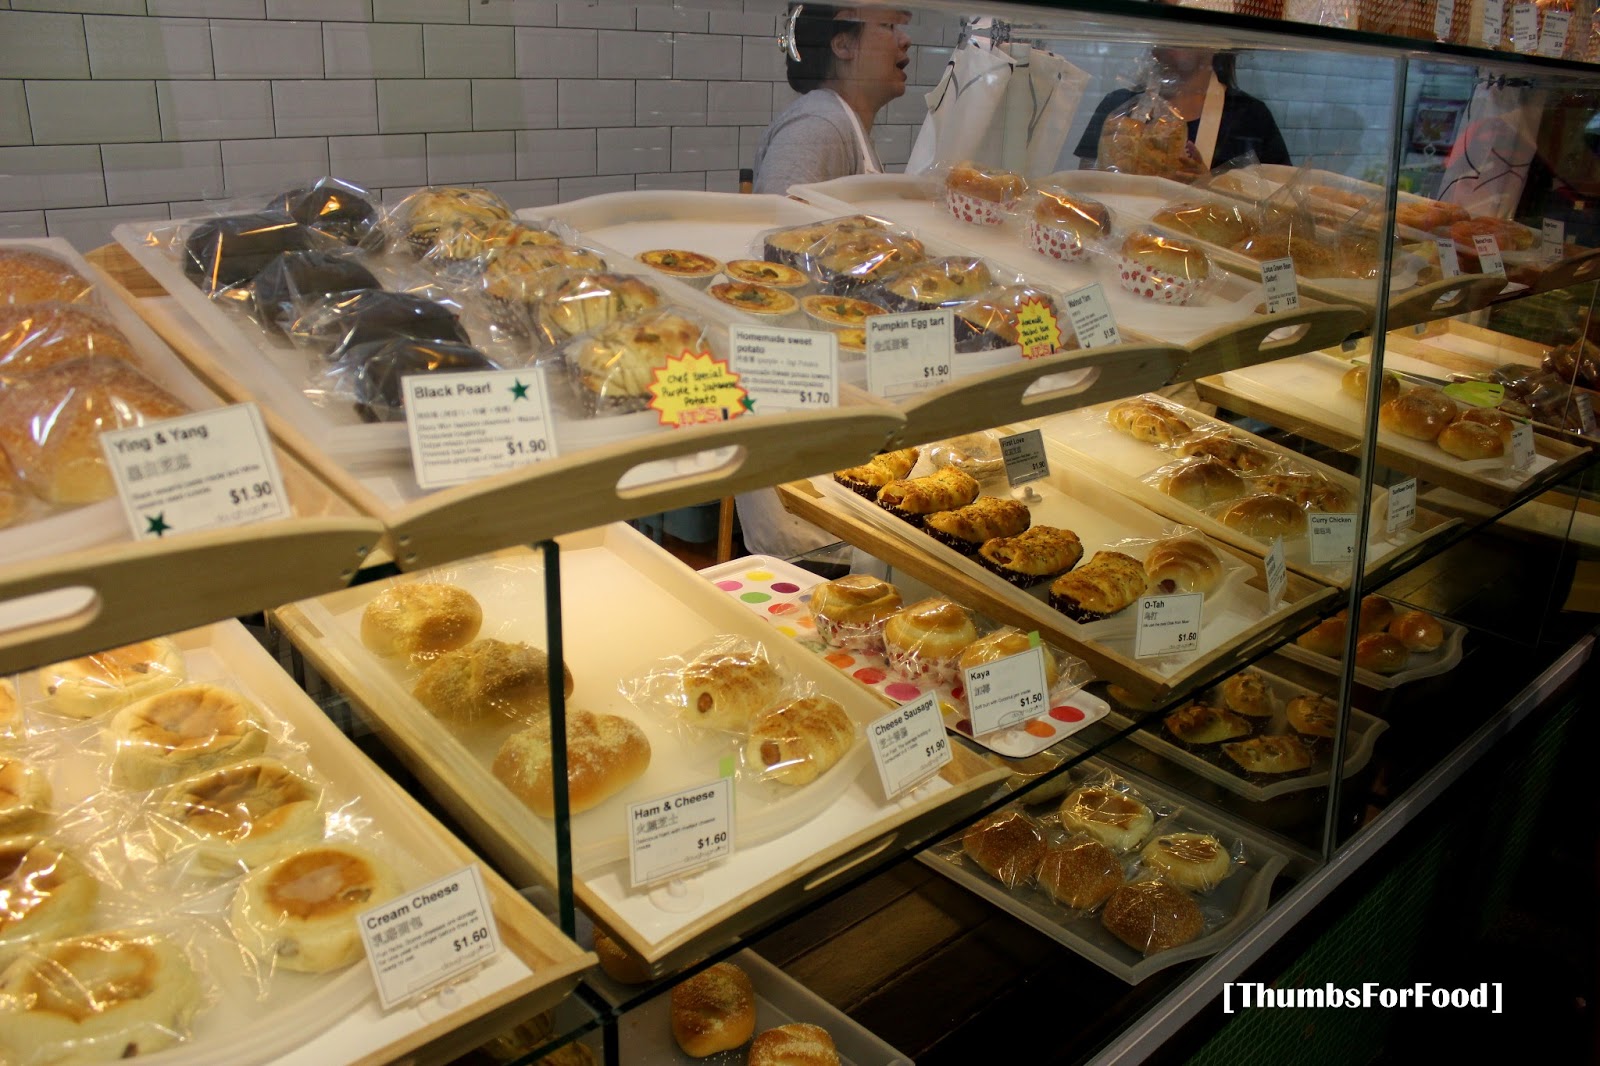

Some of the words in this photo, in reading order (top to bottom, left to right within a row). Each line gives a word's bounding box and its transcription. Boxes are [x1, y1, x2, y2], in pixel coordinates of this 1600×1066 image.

[872, 320, 909, 332] Pumpkin
[911, 318, 928, 329] Egg
[930, 317, 944, 326] tart
[737, 330, 785, 343] Homemade
[788, 336, 812, 346] sweet
[737, 344, 765, 354] potato
[667, 372, 688, 384] Chef
[693, 367, 722, 381] Special
[924, 365, 948, 377] $1.90
[414, 384, 452, 398] Black
[457, 382, 491, 395] Pearl
[661, 386, 689, 397] Purple
[800, 391, 830, 403] $1.70
[114, 437, 152, 454] Ying
[155, 431, 166, 445] &
[169, 425, 208, 442] Yang
[507, 439, 546, 455] $1.90
[229, 480, 272, 504] $1.90
[1144, 601, 1164, 609] O-Tah
[1178, 632, 1196, 642] $1.60
[970, 670, 990, 681] Kaya
[1020, 693, 1042, 707] $1.50
[875, 717, 902, 736] Cheese
[903, 698, 934, 721] Sausage
[926, 739, 944, 757] $1.90
[635, 806, 660, 820] Ham
[664, 802, 671, 812] &
[675, 790, 714, 808] Cheese
[698, 832, 726, 849] $1.60
[367, 904, 410, 930] Cream
[412, 883, 458, 910] Cheese
[453, 928, 488, 952] $1.60
